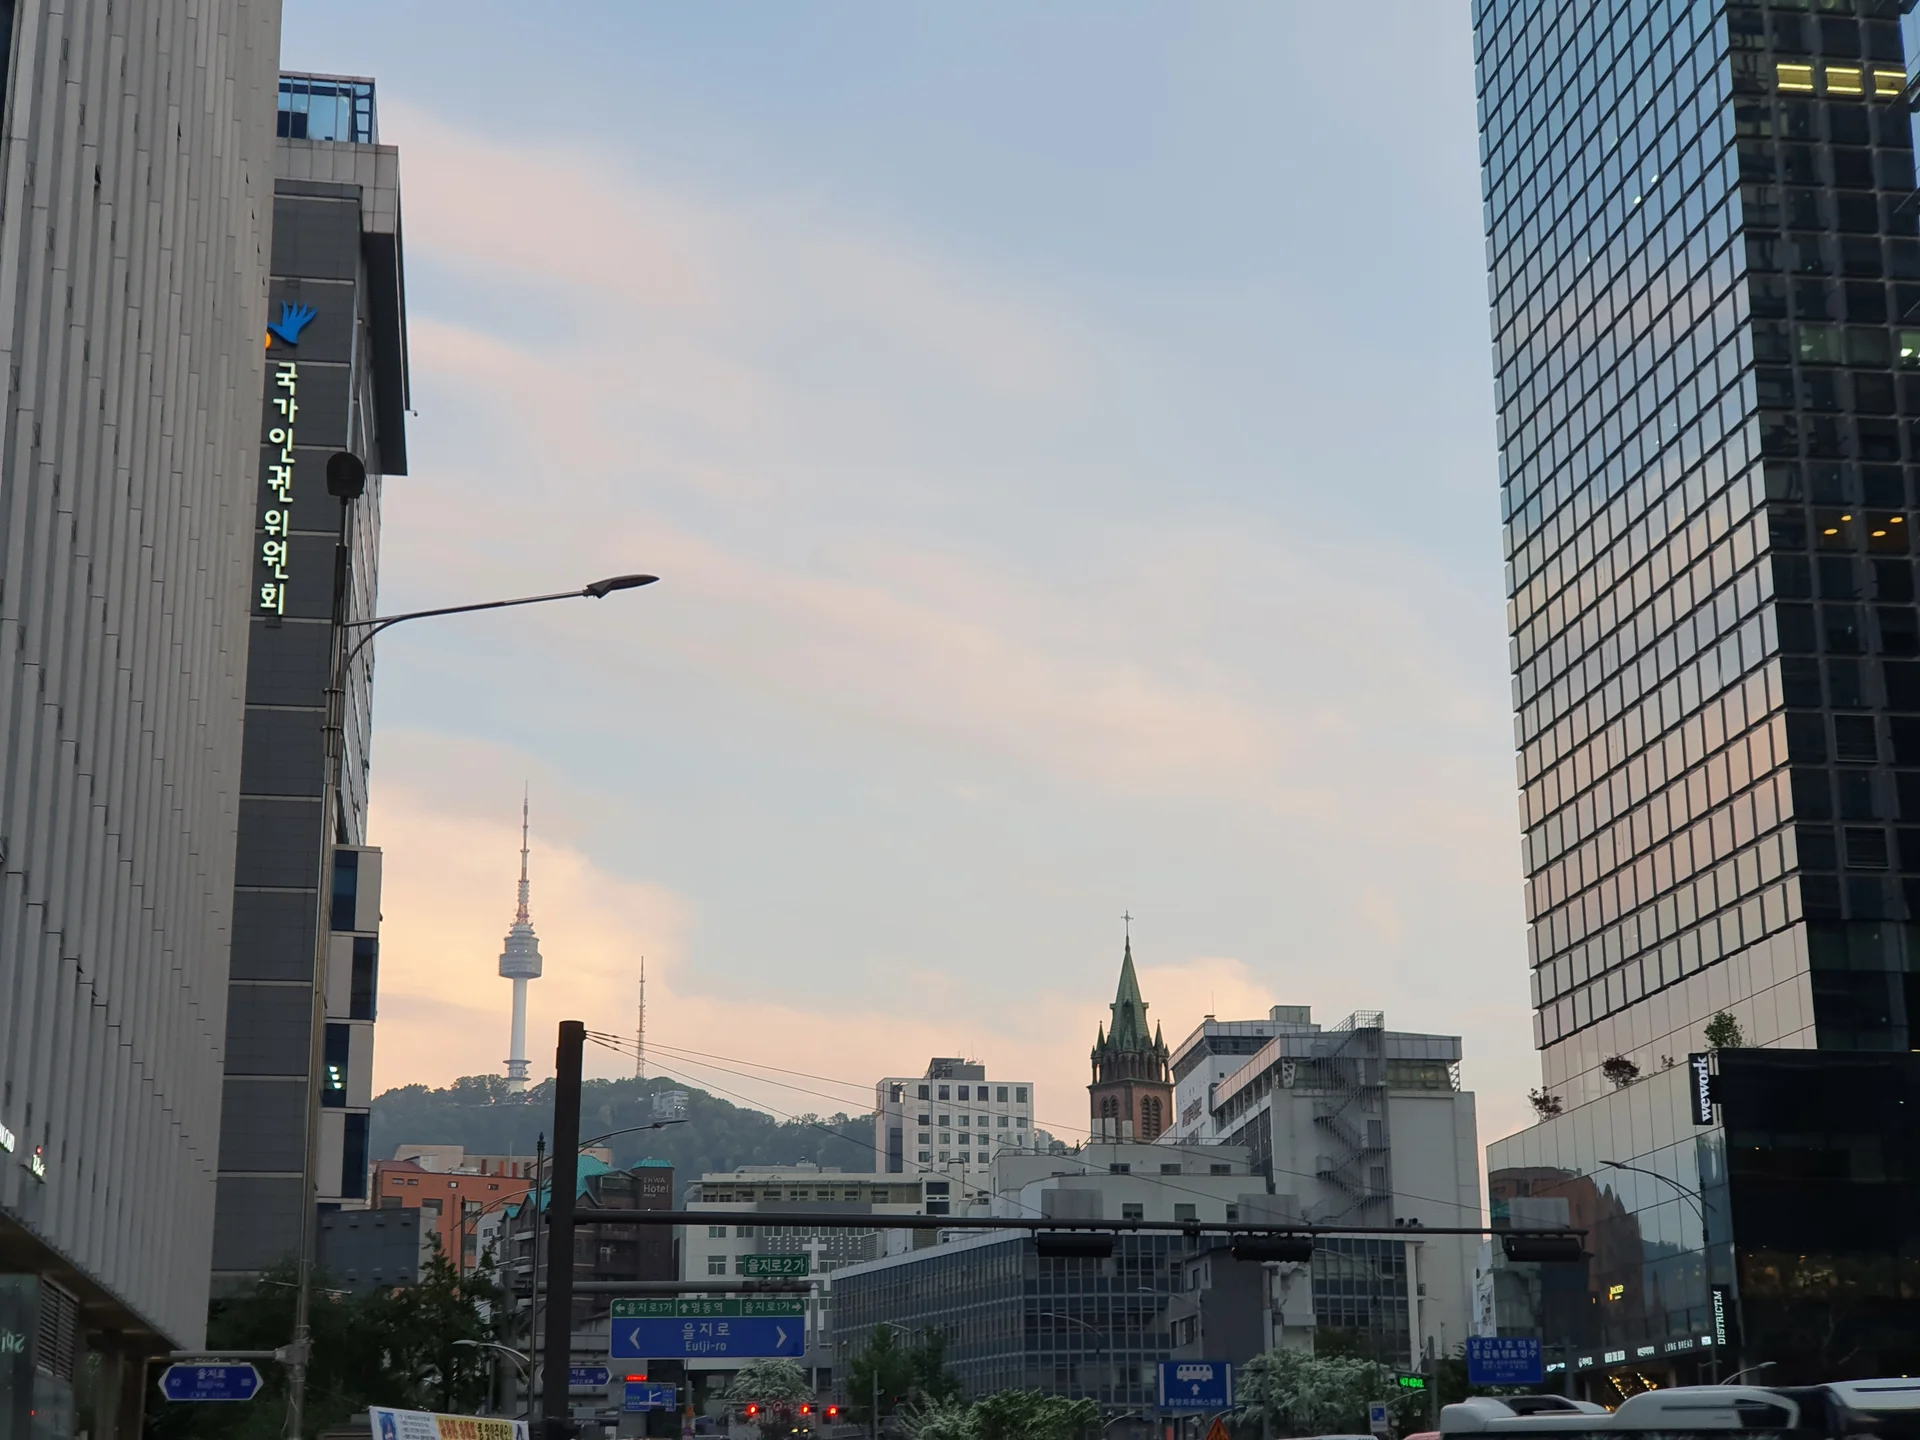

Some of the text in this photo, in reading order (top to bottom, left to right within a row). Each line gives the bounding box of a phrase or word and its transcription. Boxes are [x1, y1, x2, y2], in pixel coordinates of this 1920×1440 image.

[260, 362, 299, 615] 국가인권위원회
[1692, 1055, 1712, 1122] wework
[643, 1184, 669, 1193] Hotel
[747, 1258, 805, 1273] 을지로2가
[627, 1302, 673, 1314] 을지로3가
[691, 1302, 724, 1314] 명동역
[744, 1302, 790, 1314] 을지로1가
[681, 1322, 731, 1340] 을지로
[685, 1341, 727, 1353] Eulji-ro
[197, 1368, 227, 1380] 을지로
